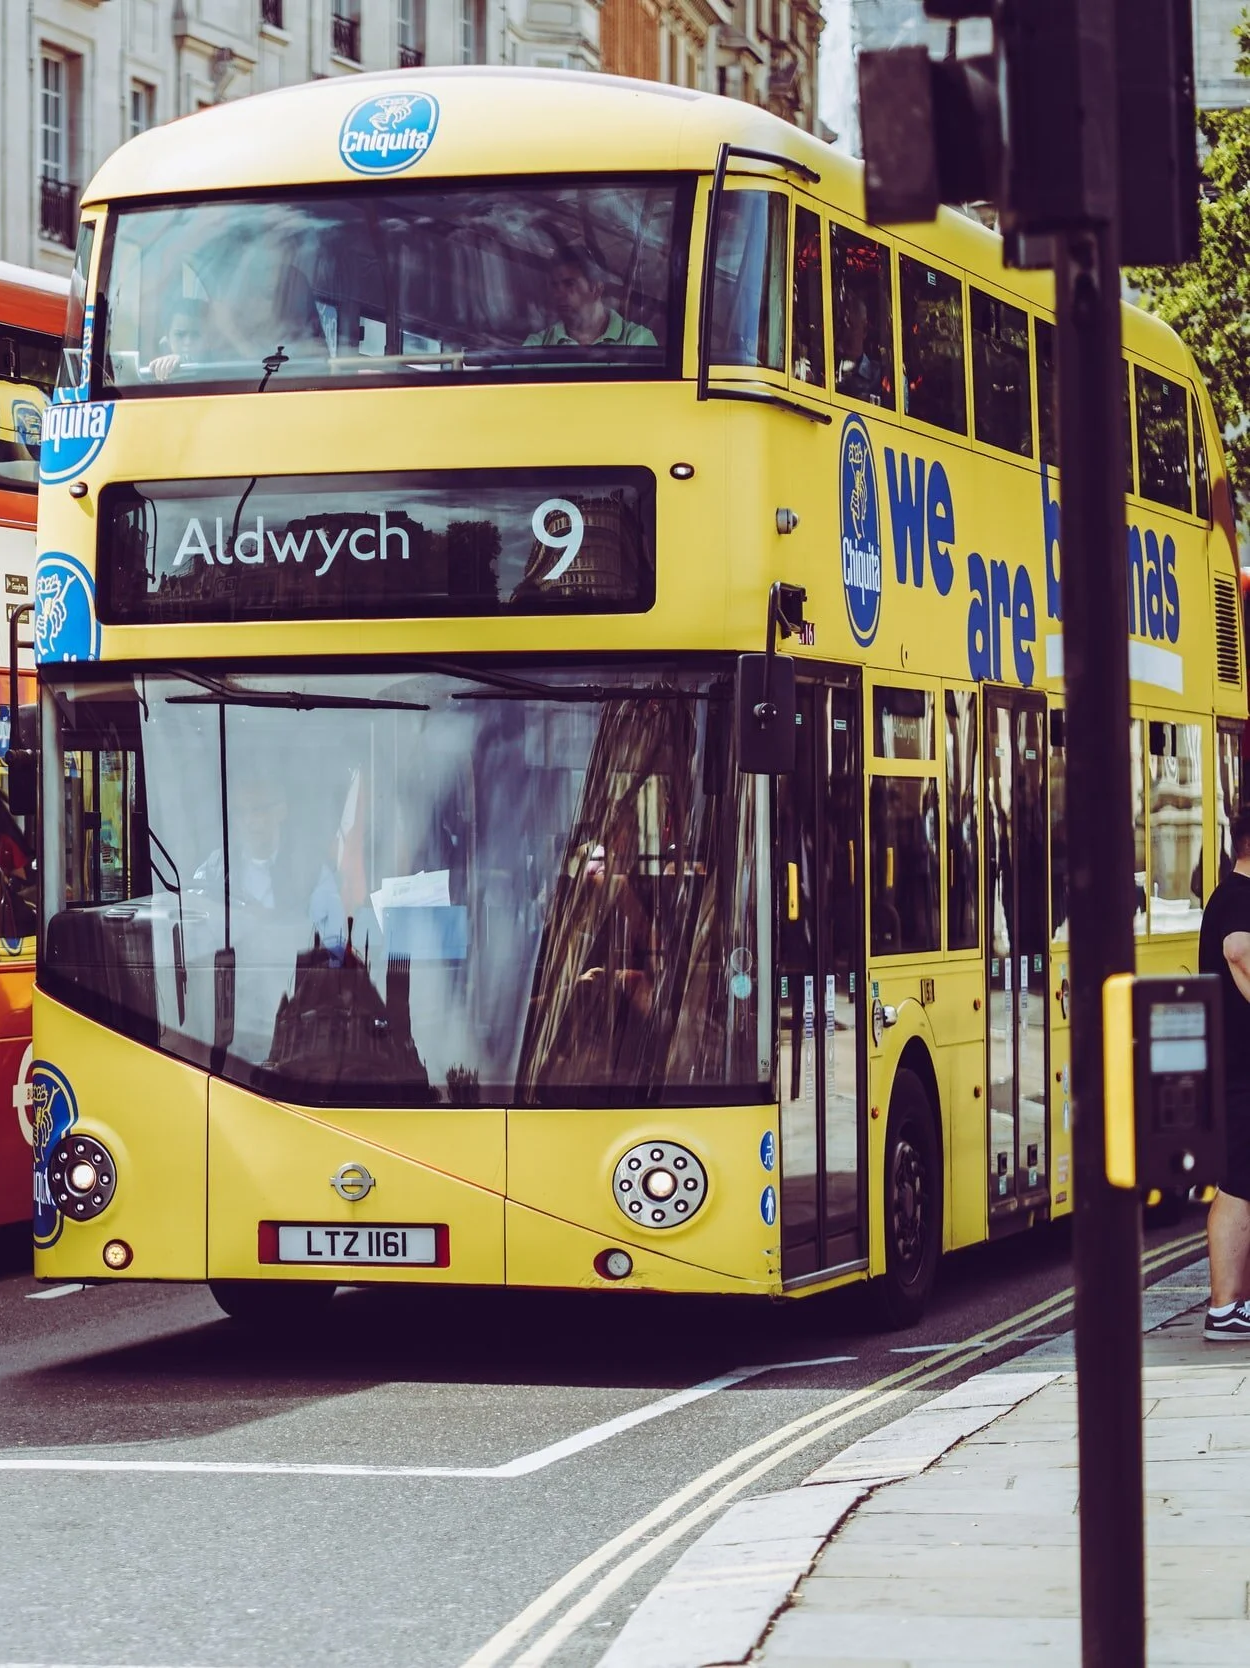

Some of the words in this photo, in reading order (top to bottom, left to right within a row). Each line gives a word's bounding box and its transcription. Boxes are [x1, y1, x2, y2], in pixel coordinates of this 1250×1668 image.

[341, 128, 431, 158] Chiquita
[172, 511, 410, 577] Aldwych
[531, 498, 584, 580] 9
[884, 446, 955, 597] we
[842, 536, 881, 605] Chiquita
[967, 552, 1036, 687] are
[306, 1230, 360, 1257] LTZ
[368, 1231, 407, 1257] 1161
